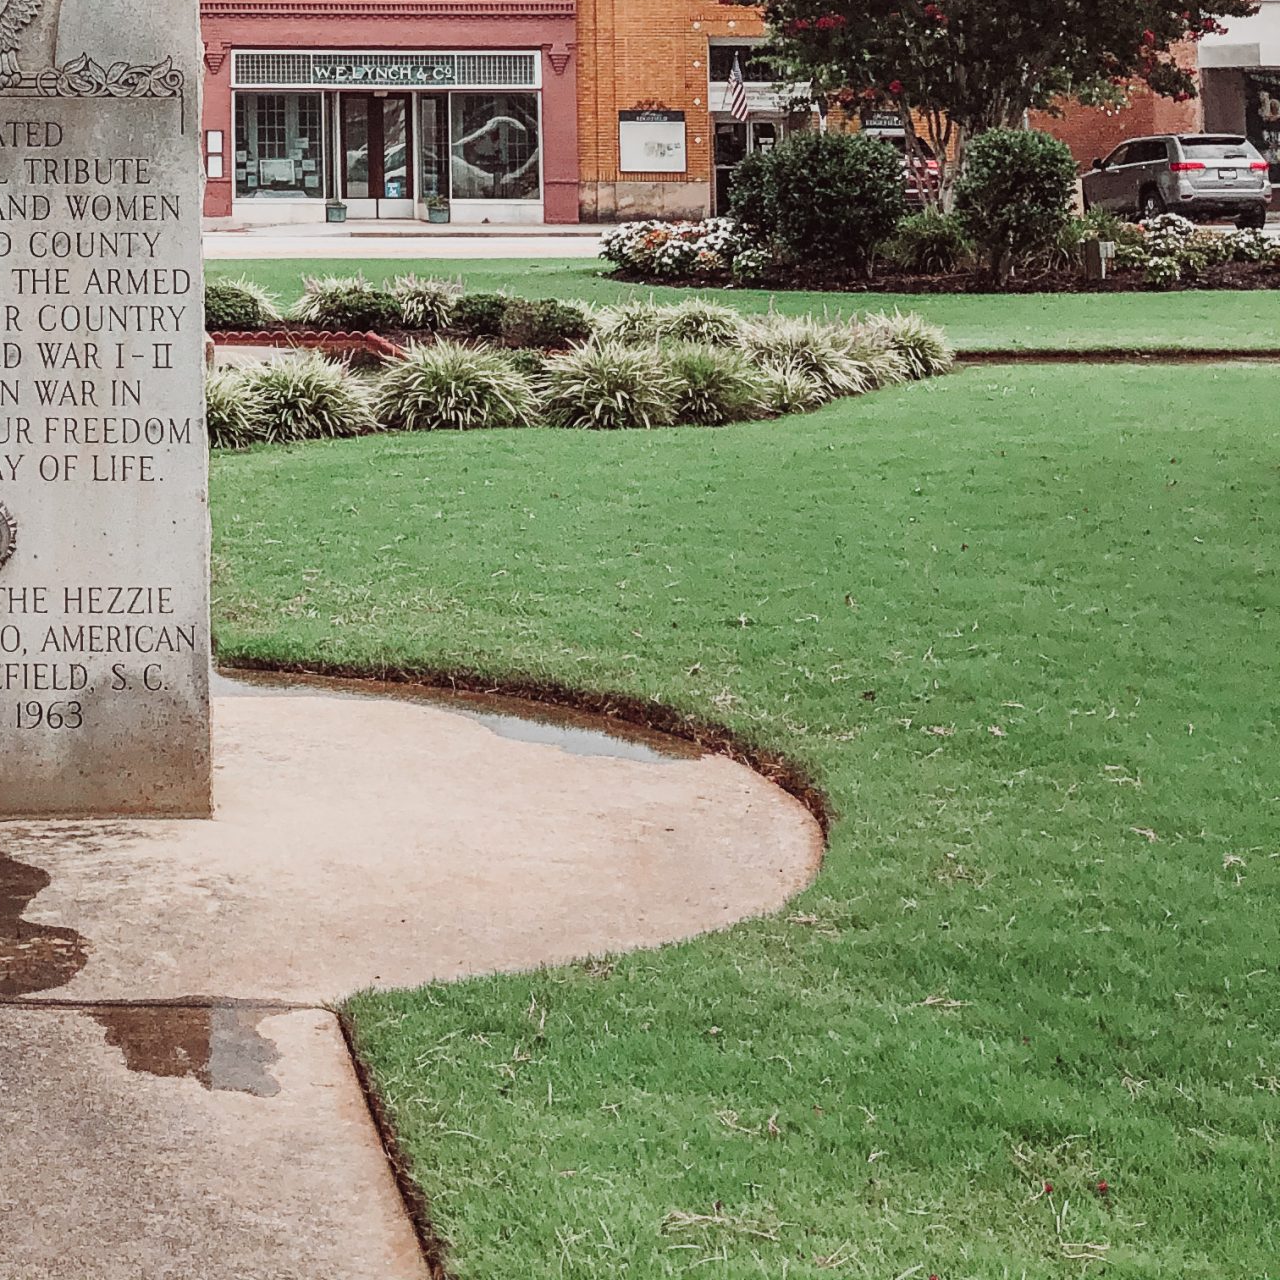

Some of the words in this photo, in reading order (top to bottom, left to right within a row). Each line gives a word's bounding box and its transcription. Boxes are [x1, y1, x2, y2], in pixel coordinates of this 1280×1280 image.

[417, 67, 427, 80] &
[24, 157, 151, 184] TRIBUTE
[65, 194, 180, 221] WOMEN
[29, 231, 162, 258] COUNTY
[11, 266, 70, 294] THE
[83, 268, 190, 296] ARMED
[39, 304, 186, 331] COUNTRY
[35, 342, 100, 369] WAR
[33, 380, 99, 408] WAR
[112, 380, 140, 406] IN
[44, 416, 191, 445] FREEDOM
[39, 455, 78, 481] OF
[91, 455, 163, 481] LIFE.
[64, 587, 174, 614] HEZZIE
[40, 624, 196, 653] AMERICAN
[111, 663, 133, 690] S.
[144, 663, 169, 691] C.
[16, 700, 82, 729] 1963
